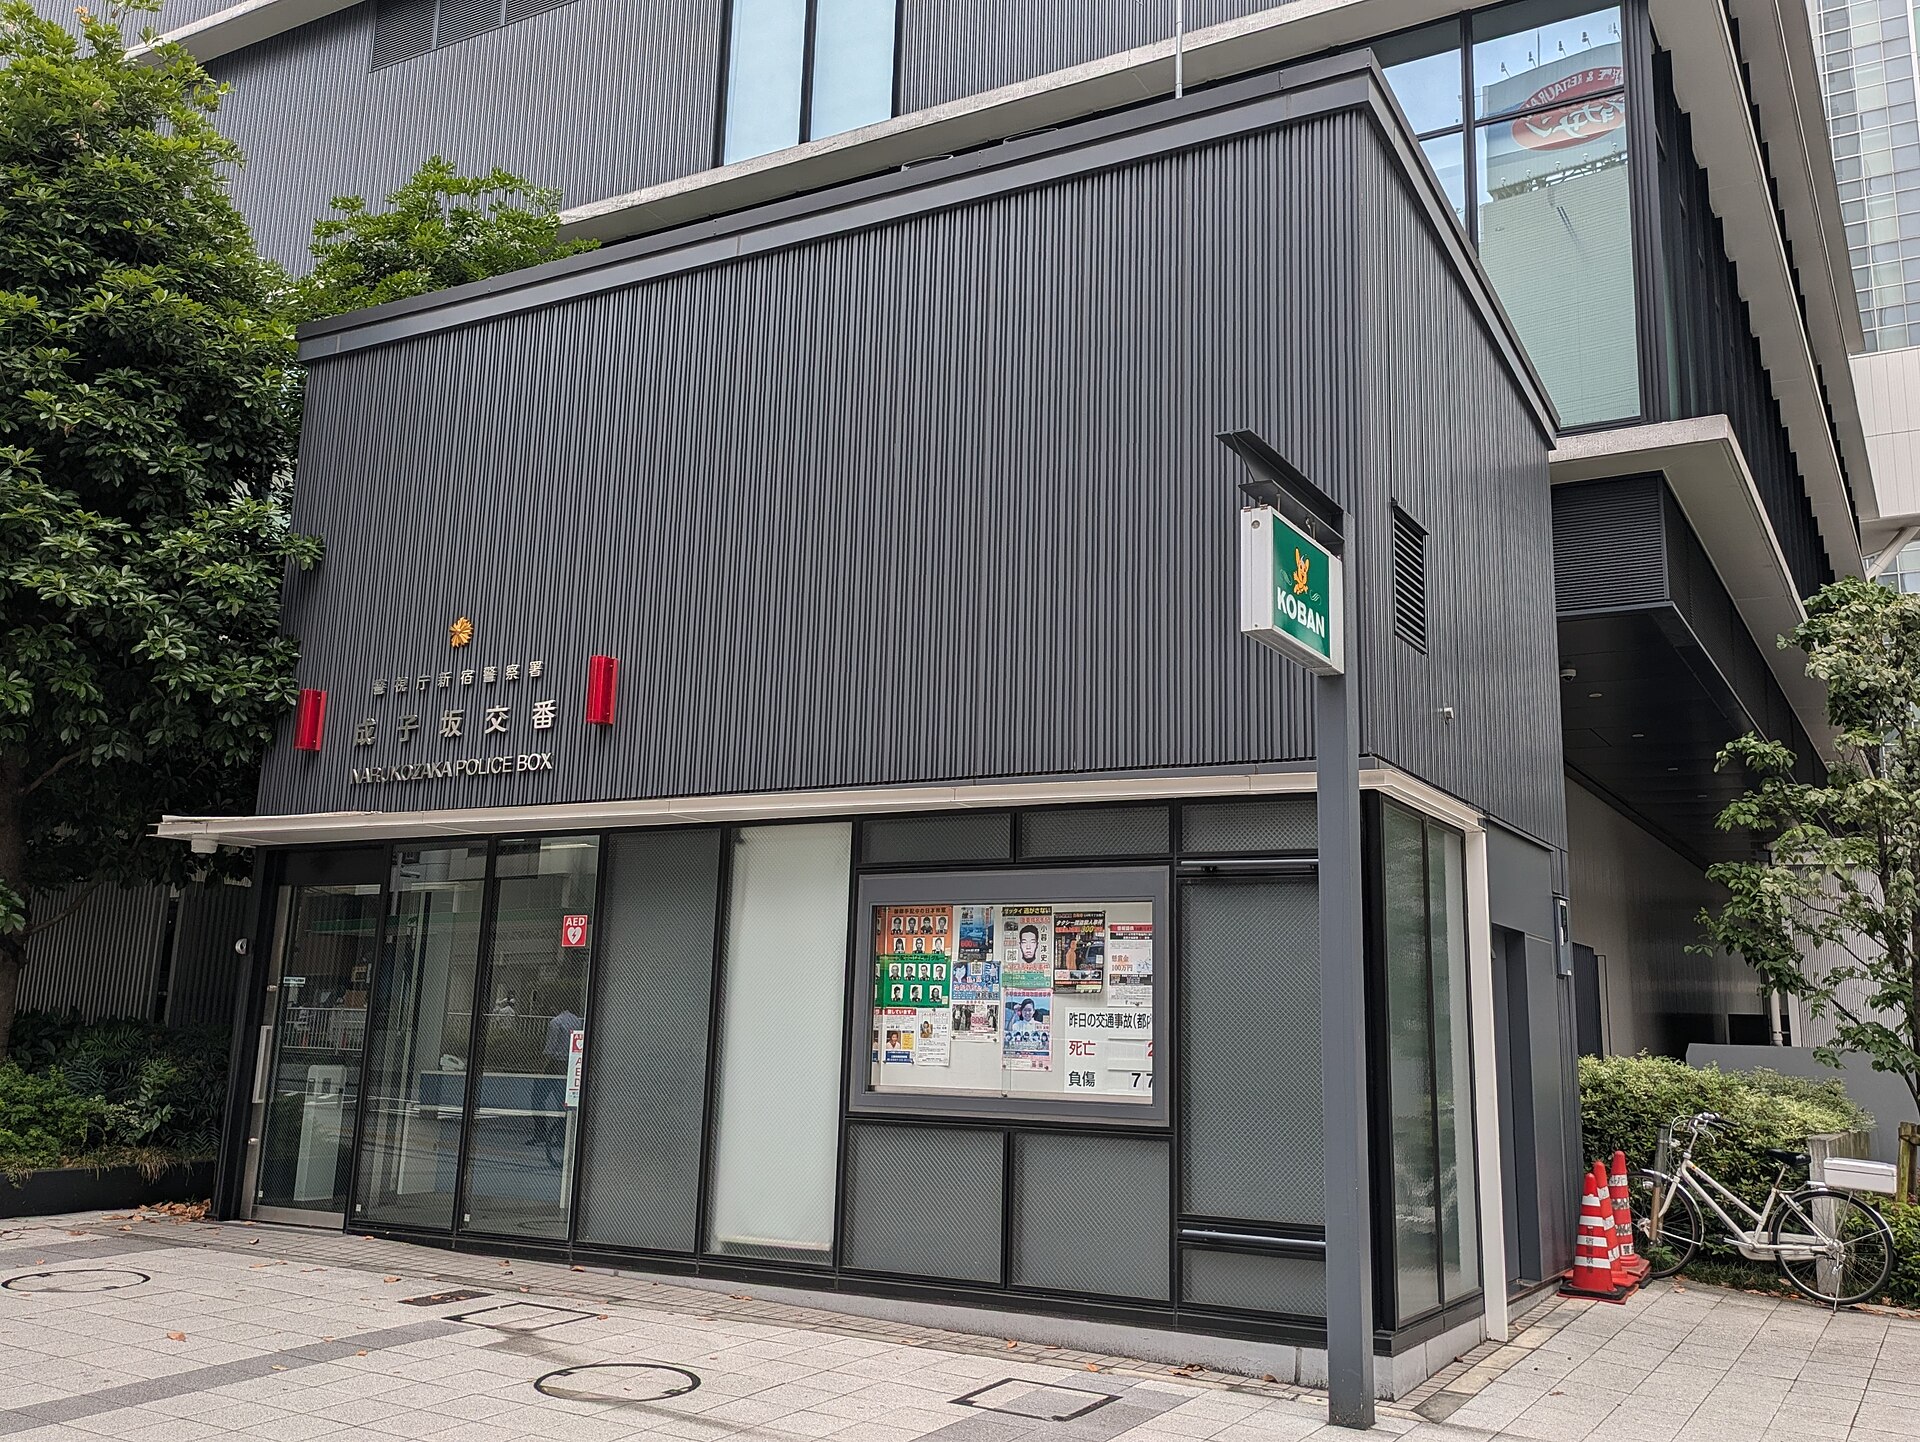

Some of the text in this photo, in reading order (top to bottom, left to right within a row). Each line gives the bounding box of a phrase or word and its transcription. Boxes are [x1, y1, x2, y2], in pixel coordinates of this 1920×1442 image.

[1277, 586, 1325, 638] KOBAN
[372, 660, 544, 695] 警視庁新宿警察署
[354, 699, 557, 747] 成子坂交番
[351, 752, 553, 785] NARUKOZAKA POLICE BOX
[566, 917, 585, 926] AED
[1068, 1040, 1096, 1056] 死亡
[1068, 1071, 1096, 1087] 負傷
